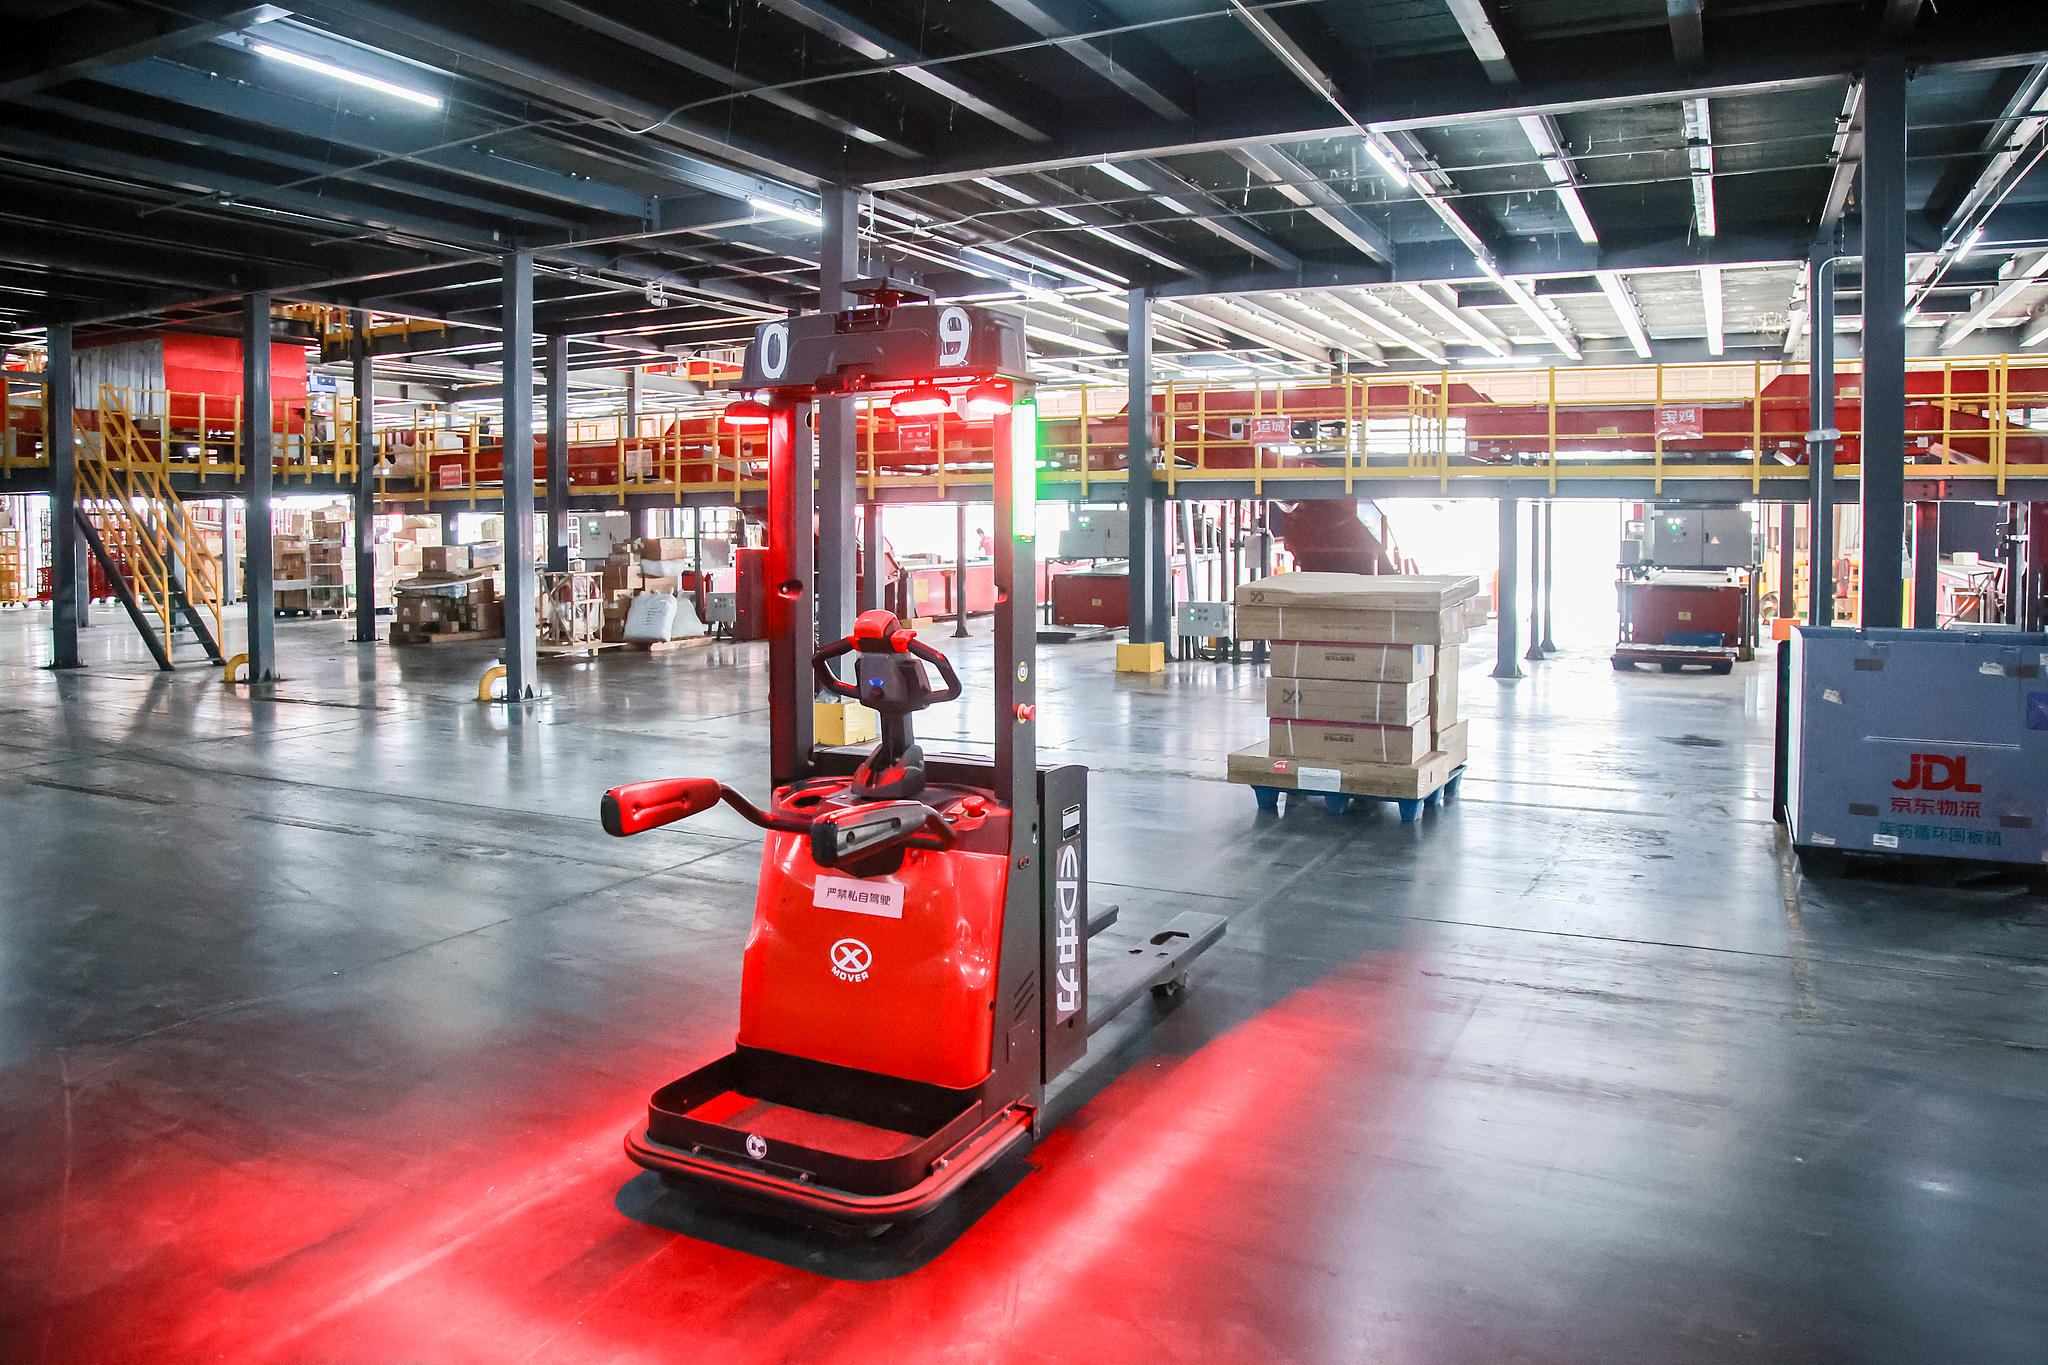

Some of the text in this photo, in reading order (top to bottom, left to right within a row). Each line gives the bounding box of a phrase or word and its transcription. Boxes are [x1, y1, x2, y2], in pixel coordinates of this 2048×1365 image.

[761, 306, 971, 379] 0 9
[1254, 420, 1285, 434] 运城
[1661, 409, 1696, 425] 宝鸡
[1891, 753, 1982, 793] JDL
[1891, 797, 1981, 818] 京东物流
[1880, 822, 2002, 846] 医药循环围板箱
[826, 887, 891, 906] 严禁私自驾驶
[831, 966, 869, 982] MOVER
